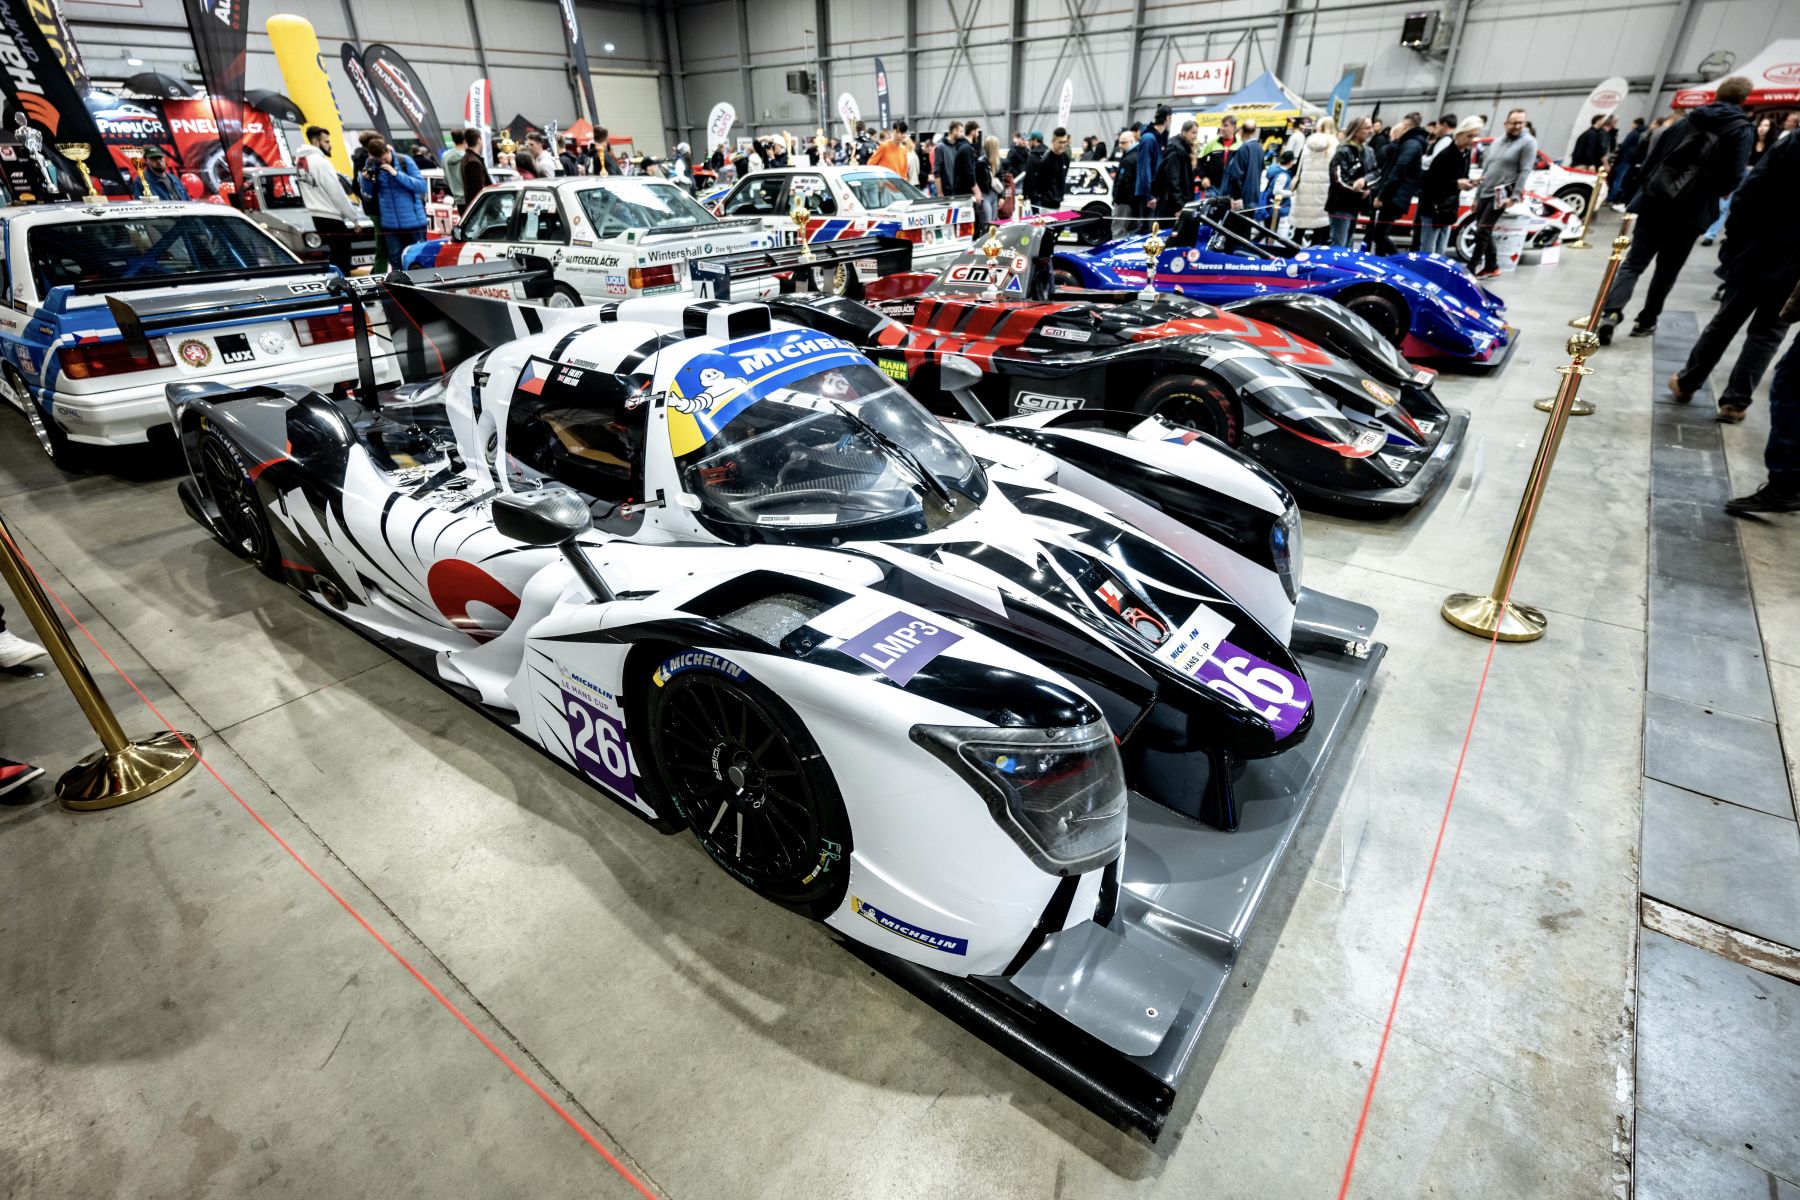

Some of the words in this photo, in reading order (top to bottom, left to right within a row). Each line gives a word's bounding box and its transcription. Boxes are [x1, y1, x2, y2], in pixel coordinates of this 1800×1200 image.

[1178, 70, 1210, 81] HALA
[1215, 69, 1221, 79] 3
[908, 216, 928, 226] Mobil
[648, 246, 702, 262] Wintershall
[1016, 259, 1024, 268] E
[1198, 262, 1223, 270] Tereza
[606, 276, 625, 285] LIQUI
[608, 285, 627, 294] MOLY
[223, 350, 254, 363] LUX
[879, 360, 907, 371] MANN
[210, 424, 250, 479] MICHELIN
[859, 619, 939, 670] LMP3
[1170, 628, 1199, 659] MICHIN
[669, 653, 743, 679] MICHELIN
[561, 680, 571, 689] LE
[572, 686, 591, 702] MANS
[595, 699, 609, 711] CUP
[571, 673, 613, 700] MICHELIN
[568, 701, 627, 778] 26
[712, 742, 727, 781] LIGIER
[879, 917, 957, 949] MICHELIN
